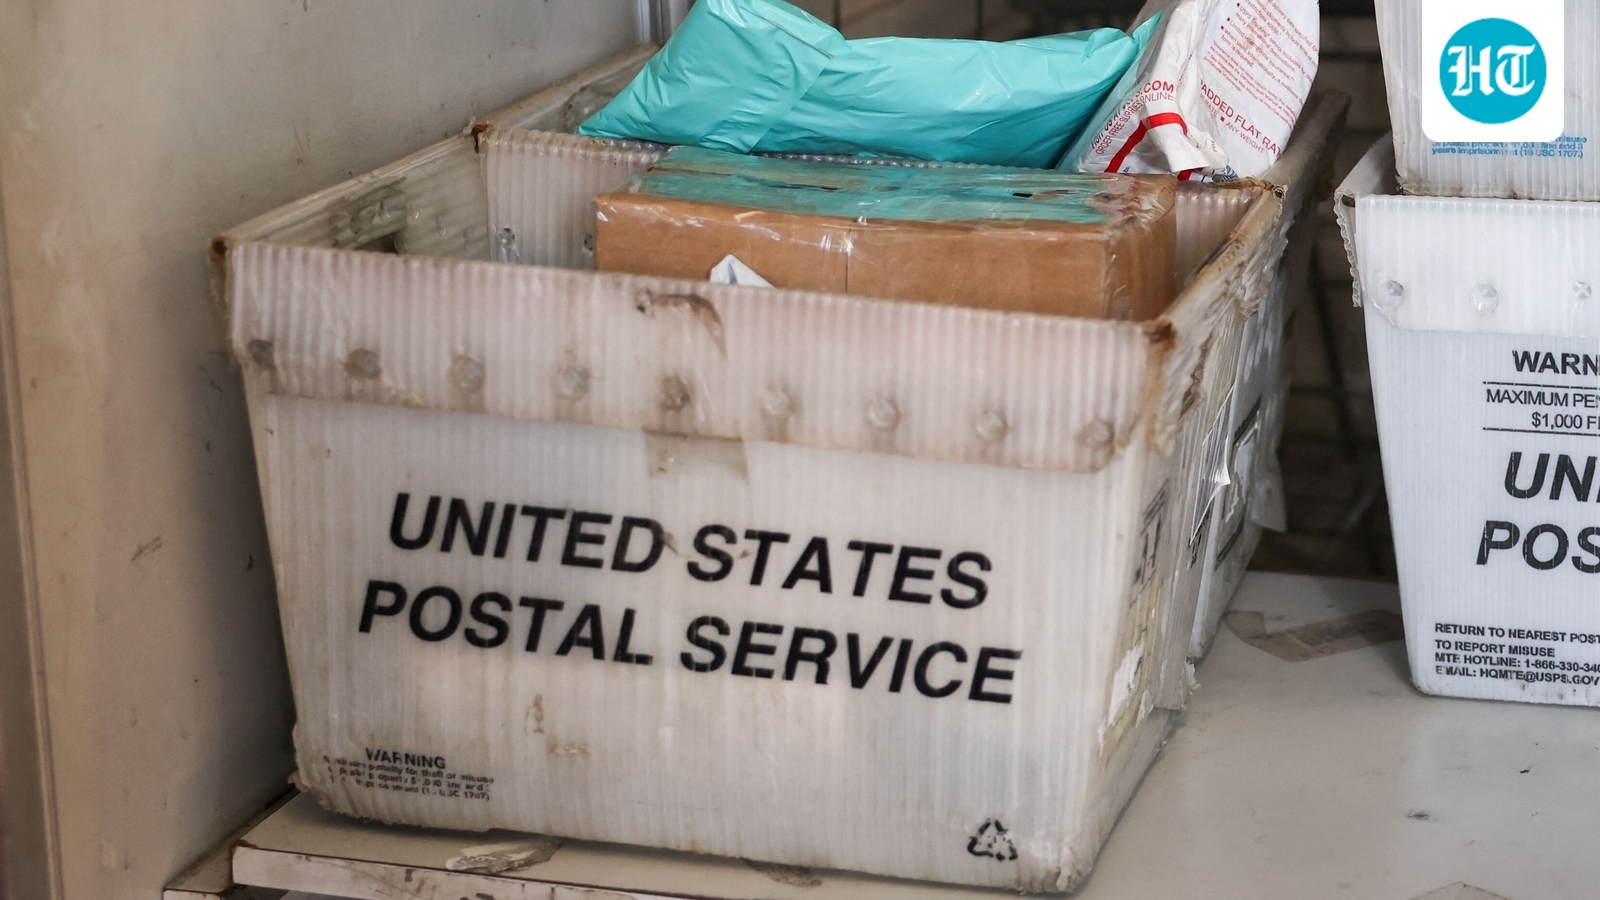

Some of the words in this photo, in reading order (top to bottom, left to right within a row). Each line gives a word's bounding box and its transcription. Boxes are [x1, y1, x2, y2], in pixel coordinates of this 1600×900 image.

[1268, 37, 1283, 52] service
[1282, 50, 1301, 69] included
[1108, 120, 1125, 137] FREE
[1139, 91, 1174, 104] ONLINE
[1200, 80, 1234, 117] ADDED
[1235, 115, 1261, 139] FLAT
[1226, 121, 1240, 134] ANY
[1240, 131, 1265, 154] WEIGHT
[1486, 389, 1569, 407] MAXIMUM
[1532, 412, 1583, 430] $1,000
[1504, 451, 1600, 503] UN
[388, 492, 668, 575] UNITED
[685, 523, 993, 610] STATES
[1476, 520, 1600, 573] POS
[358, 579, 654, 667] POSTAL
[679, 615, 1024, 705] SERVICE
[1435, 623, 1485, 637] RETURN
[1488, 627, 1506, 638] TO
[1508, 629, 1567, 643] NEAREST
[1435, 639, 1452, 650] TO
[1454, 642, 1505, 655] REPORT
[1508, 646, 1556, 658] MISUSE
[365, 747, 446, 770] WARNING
